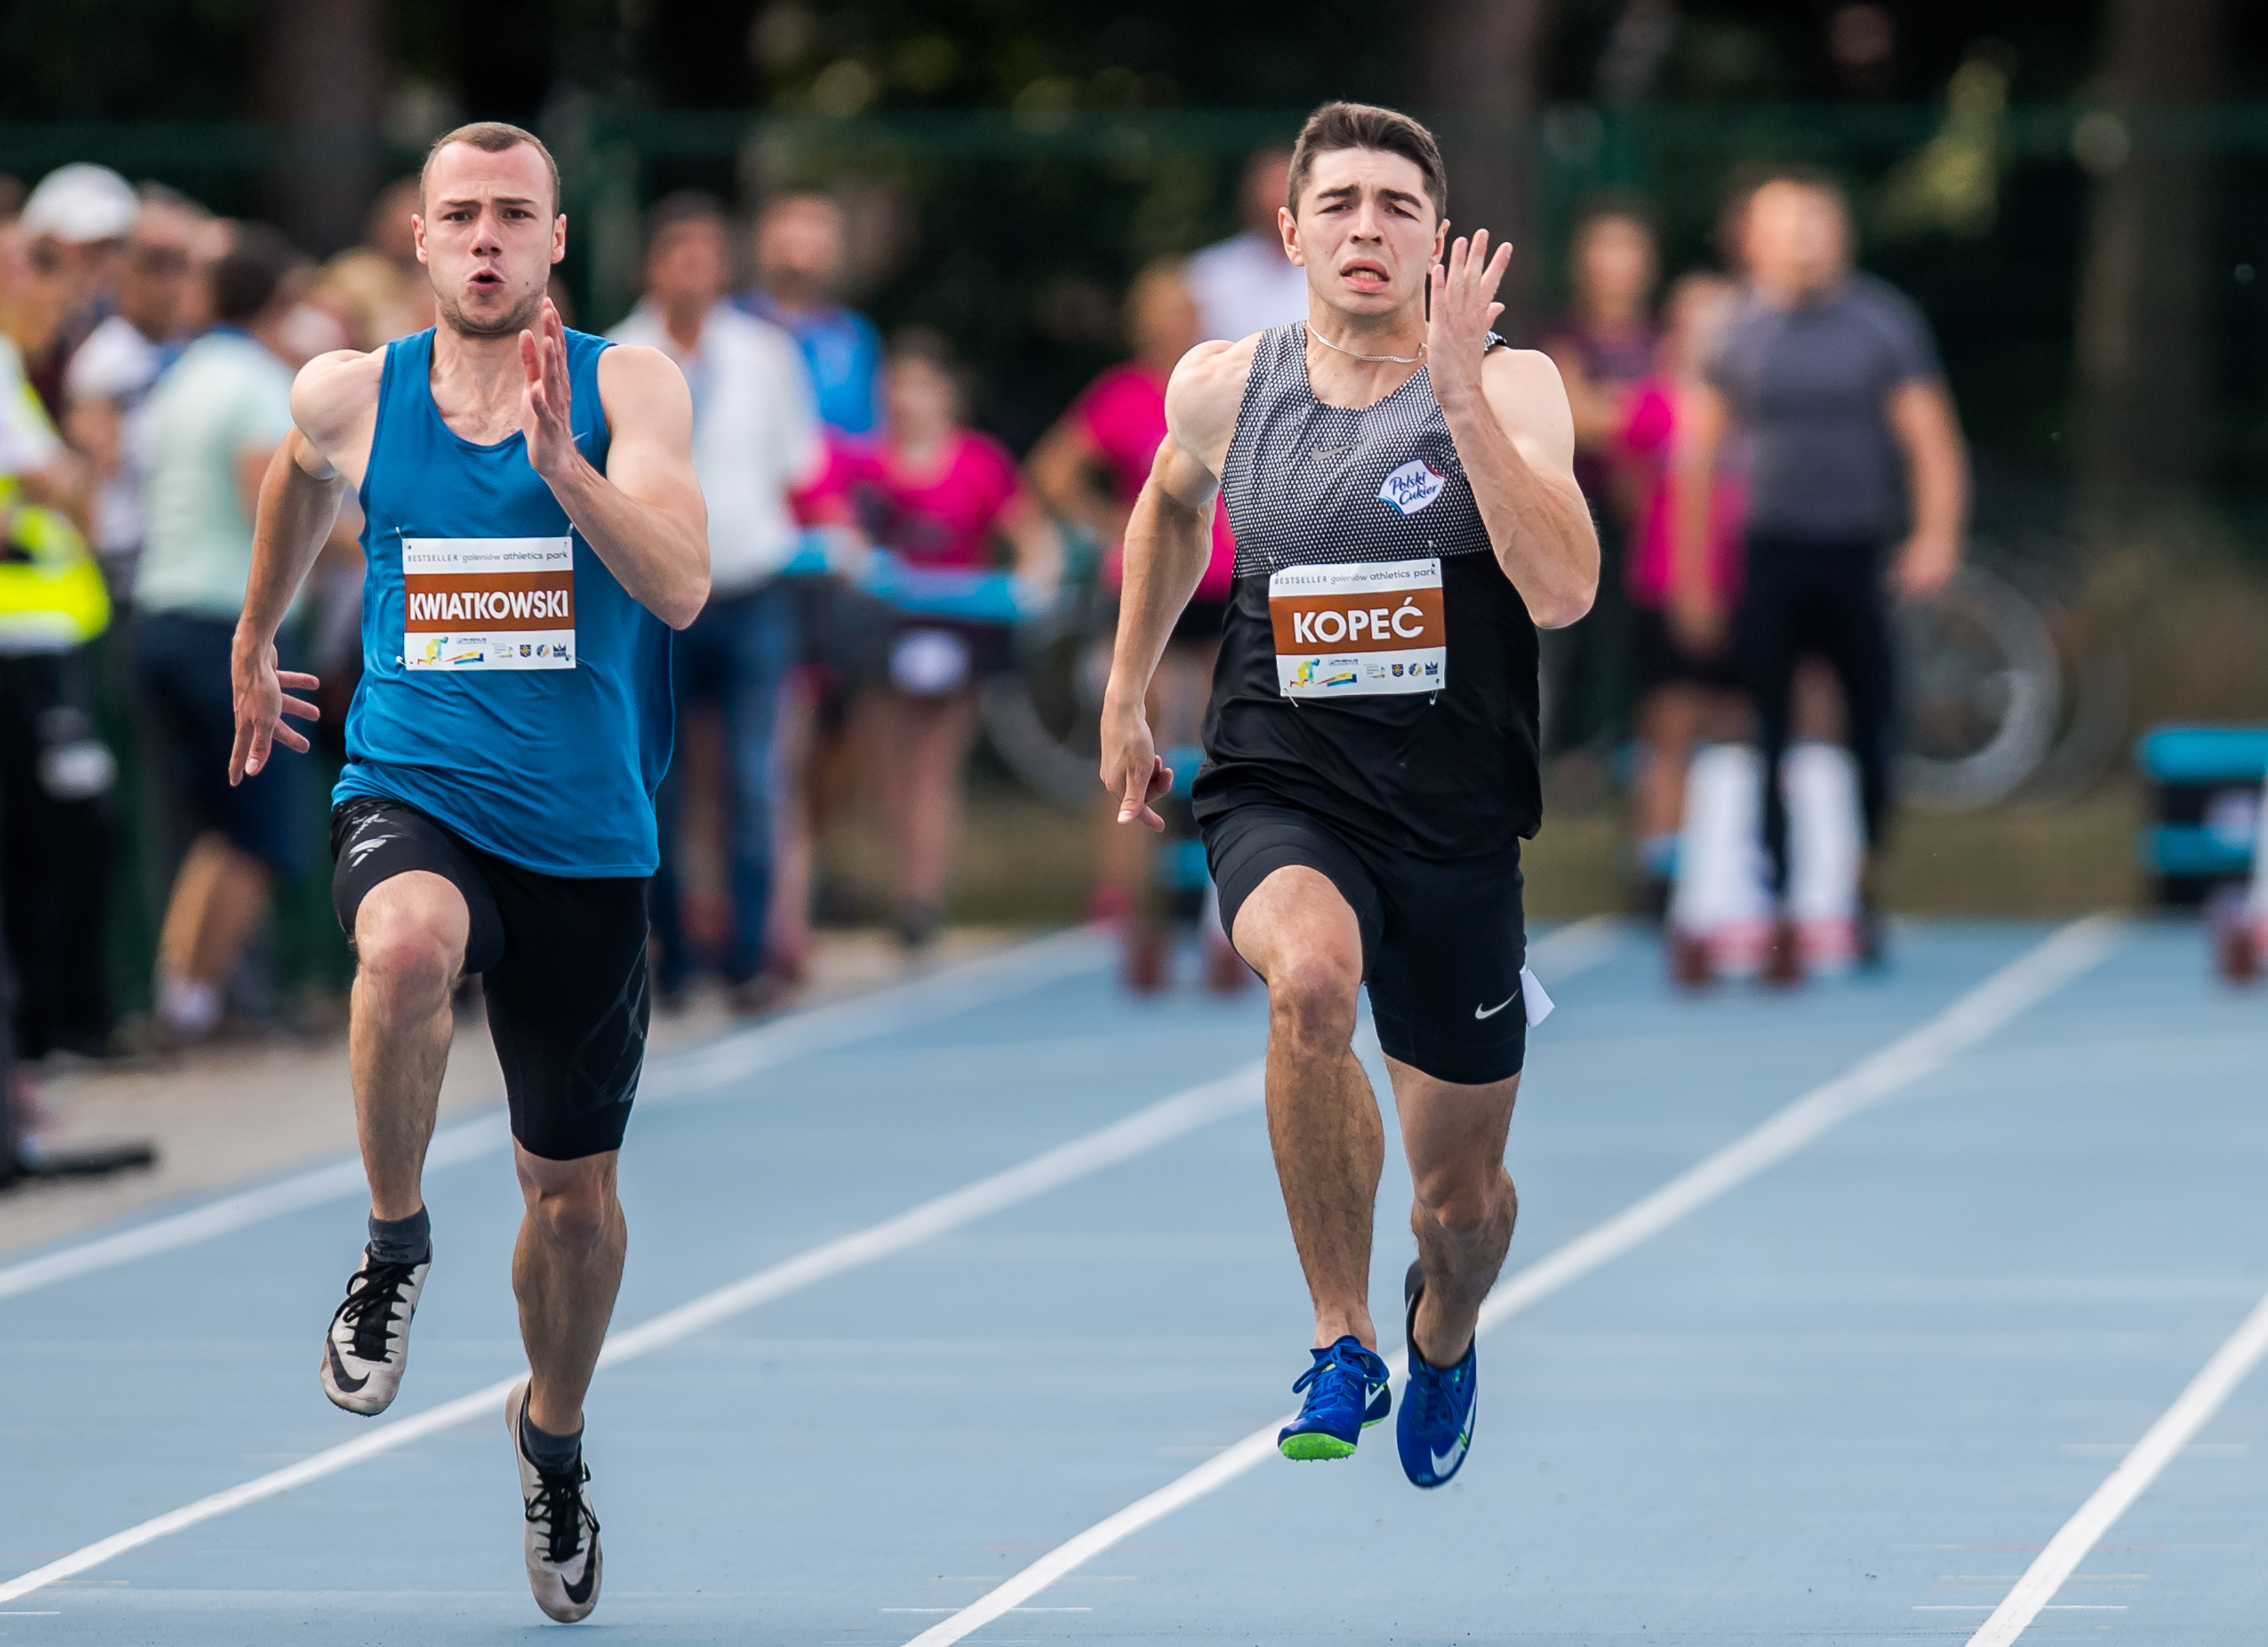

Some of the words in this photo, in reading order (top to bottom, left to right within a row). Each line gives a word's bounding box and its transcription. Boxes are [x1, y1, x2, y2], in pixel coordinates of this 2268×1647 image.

[1389, 471, 1426, 495] Polski
[407, 554, 459, 562] BESTSELLER
[503, 551, 543, 560] athletics
[547, 551, 569, 561] park
[1274, 575, 1327, 584] BESTSELLER
[1370, 570, 1410, 581] athletics
[1414, 568, 1436, 579] park
[409, 590, 569, 621] KWIATKOWSKI
[1293, 596, 1424, 643] KOPEĆ
